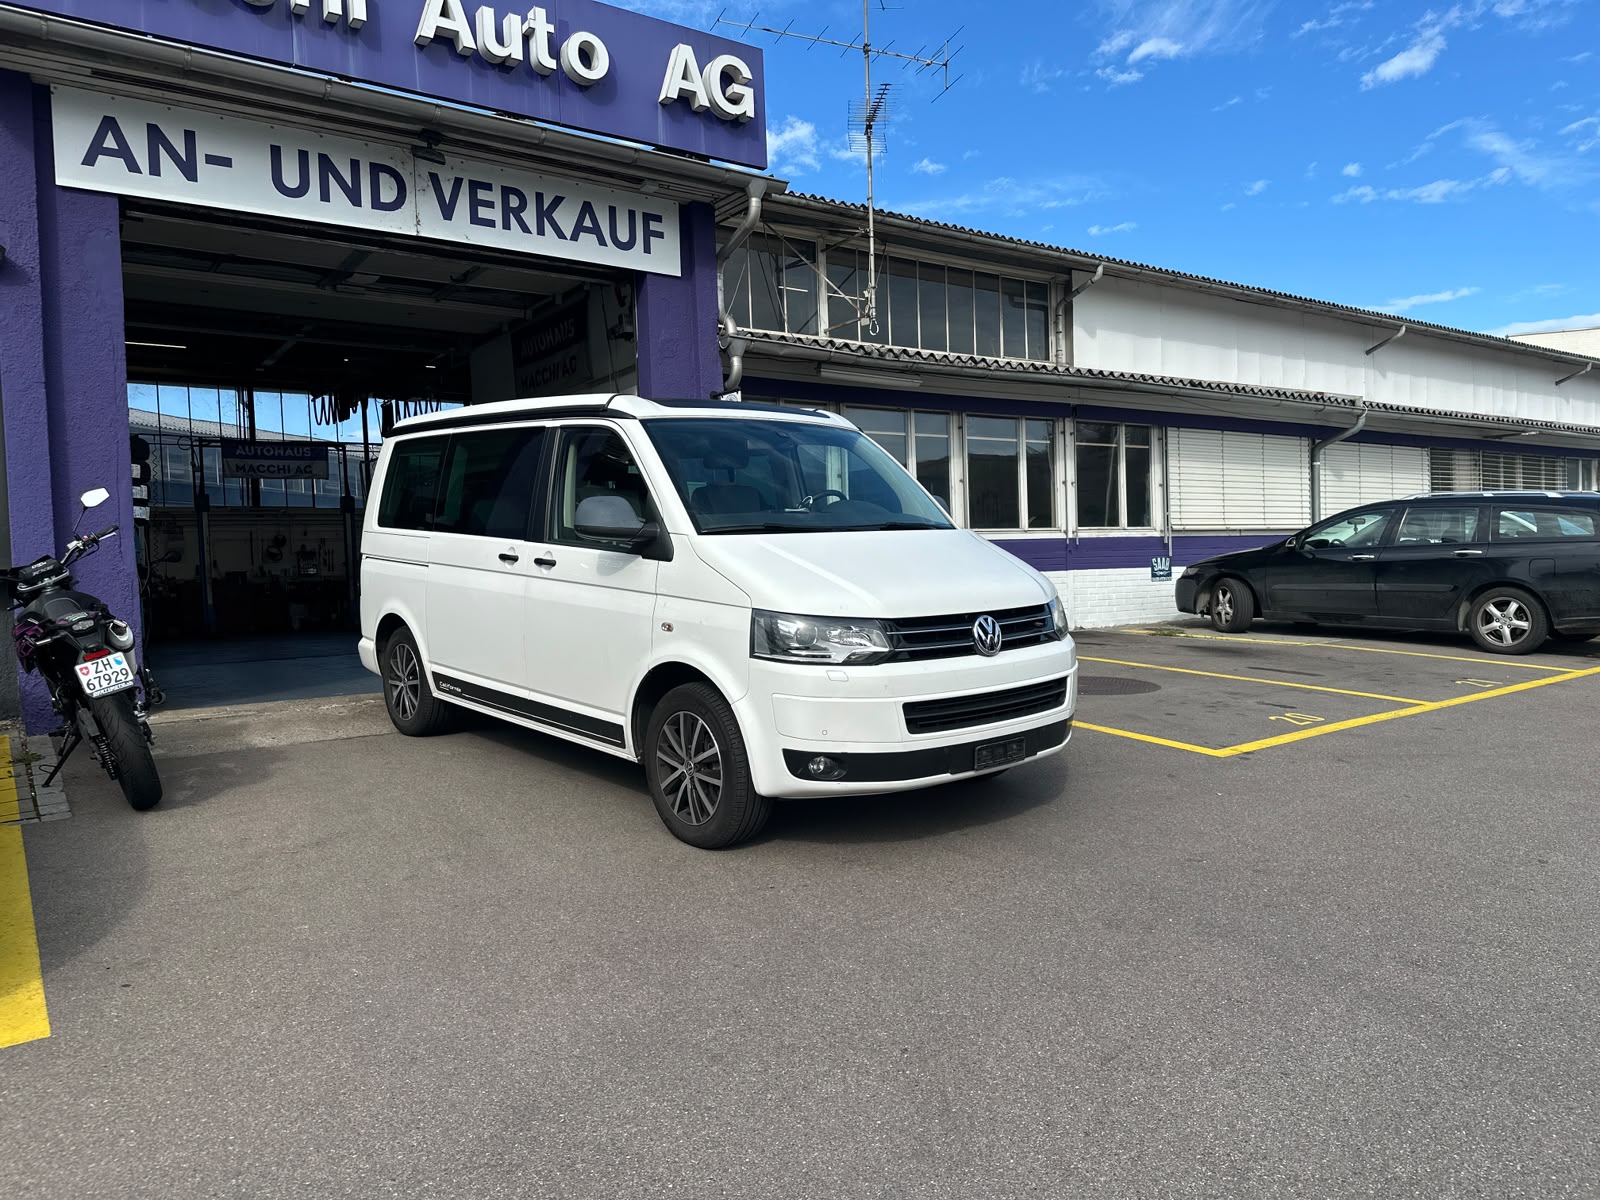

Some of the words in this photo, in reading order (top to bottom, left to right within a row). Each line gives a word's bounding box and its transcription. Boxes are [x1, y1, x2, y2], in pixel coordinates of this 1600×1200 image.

[414, 0, 610, 87] Auto
[659, 43, 755, 122] AG
[81, 115, 233, 183] AN-
[270, 144, 408, 213] UND
[429, 173, 666, 255] VERKAUF
[235, 446, 312, 457] AUTOHAUS
[235, 463, 291, 475] MACCHI
[295, 464, 313, 475] AG
[91, 658, 113, 674] ZH
[86, 668, 129, 691] 67929
[1268, 712, 1325, 726] 20
